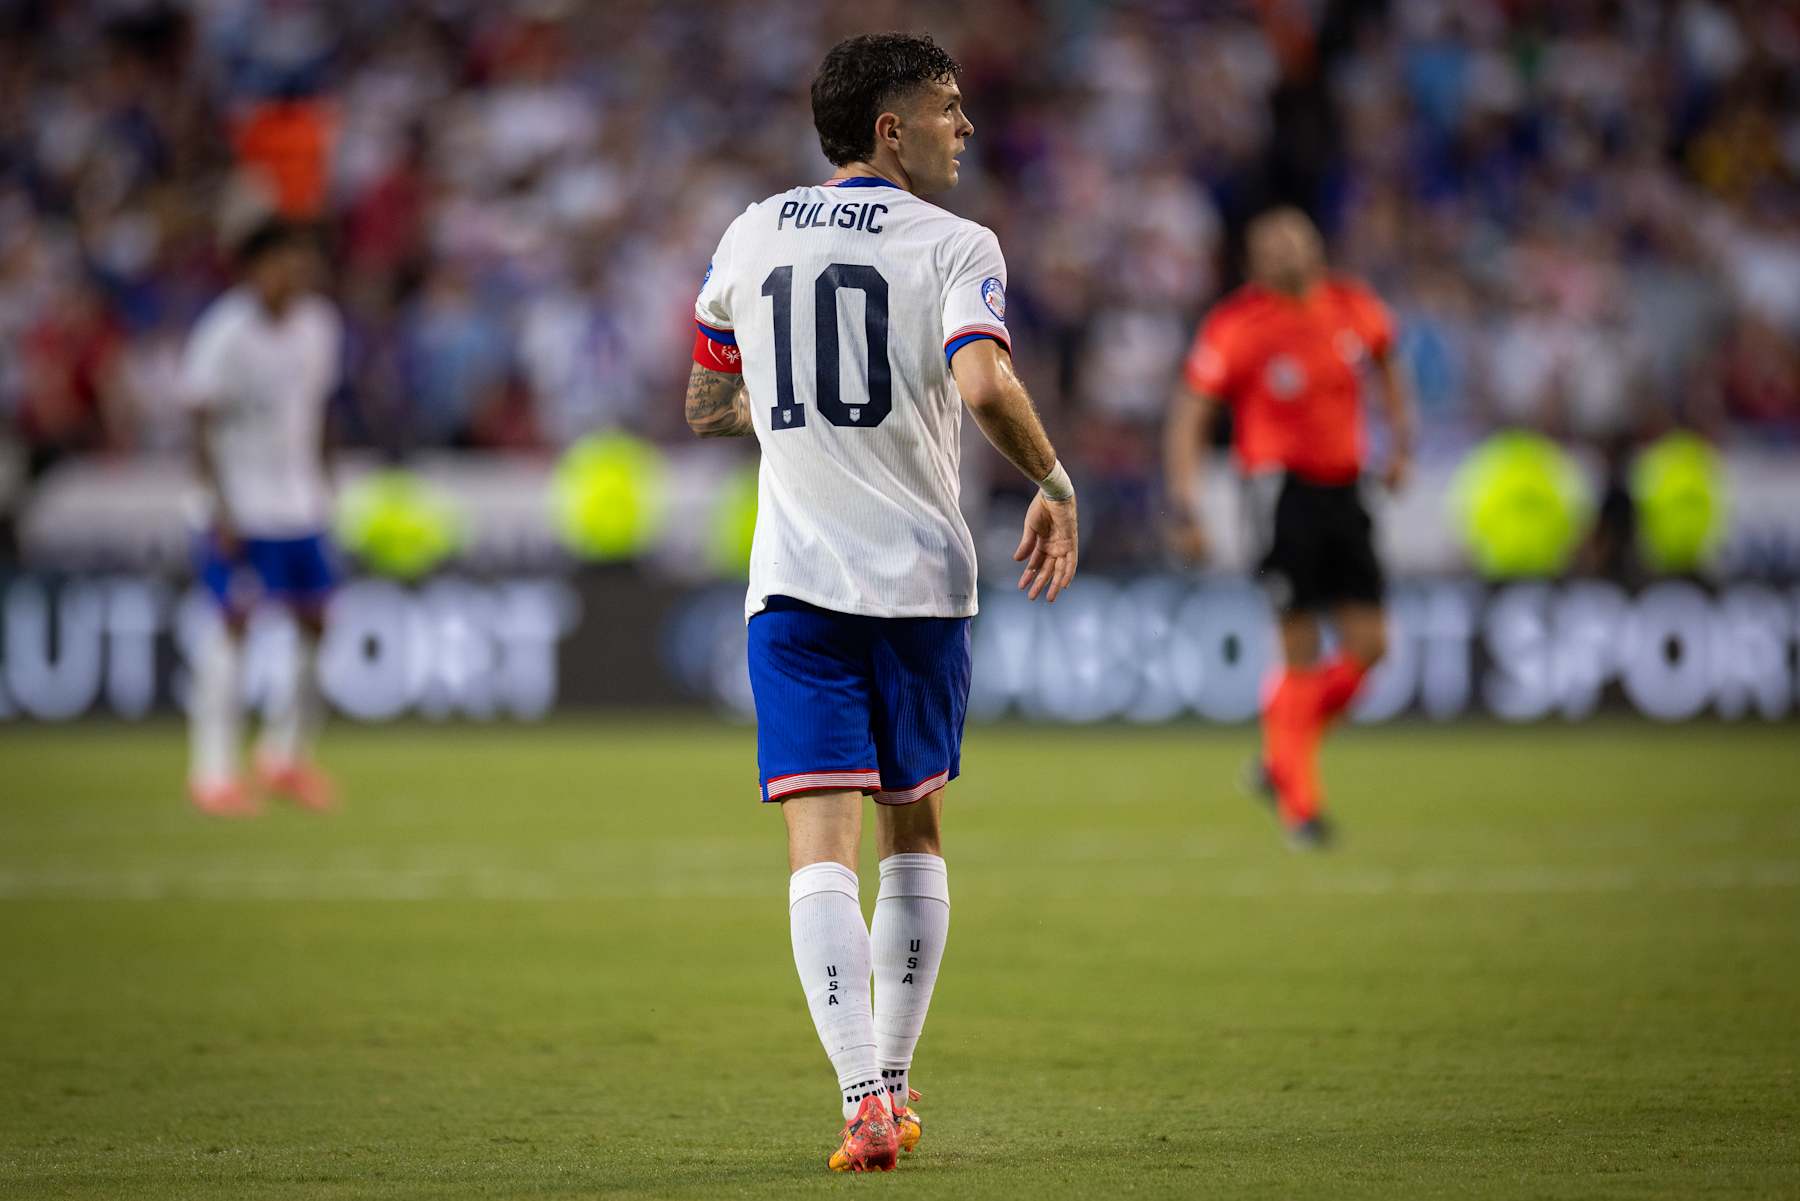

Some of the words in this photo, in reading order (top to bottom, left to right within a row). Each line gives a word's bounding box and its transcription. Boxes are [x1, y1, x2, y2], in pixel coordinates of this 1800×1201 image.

[778, 201, 888, 234] PULISIC
[761, 263, 892, 431] 10
[0, 578, 165, 721] UT
[1482, 577, 1800, 722] SPOR
[827, 965, 839, 1006] USA
[902, 940, 920, 984] USA
